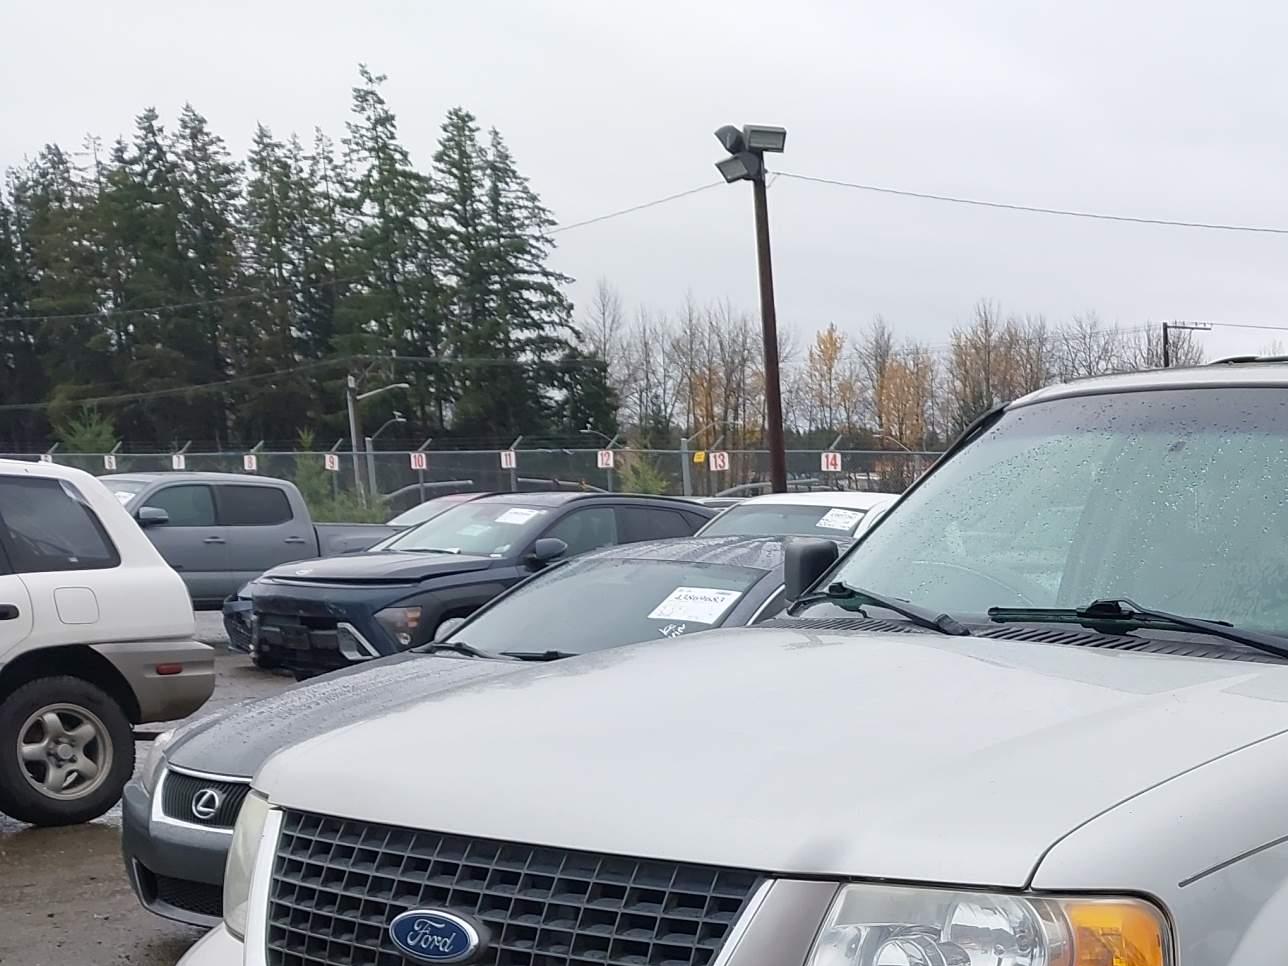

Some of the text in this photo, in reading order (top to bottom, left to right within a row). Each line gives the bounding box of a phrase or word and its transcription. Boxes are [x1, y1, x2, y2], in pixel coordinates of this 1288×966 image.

[328, 455, 336, 469] 9
[412, 453, 424, 468] 10
[503, 452, 513, 466] 11
[600, 452, 611, 466] 12
[713, 453, 726, 469] 13
[825, 453, 839, 470] 14
[407, 918, 457, 953] Ford
